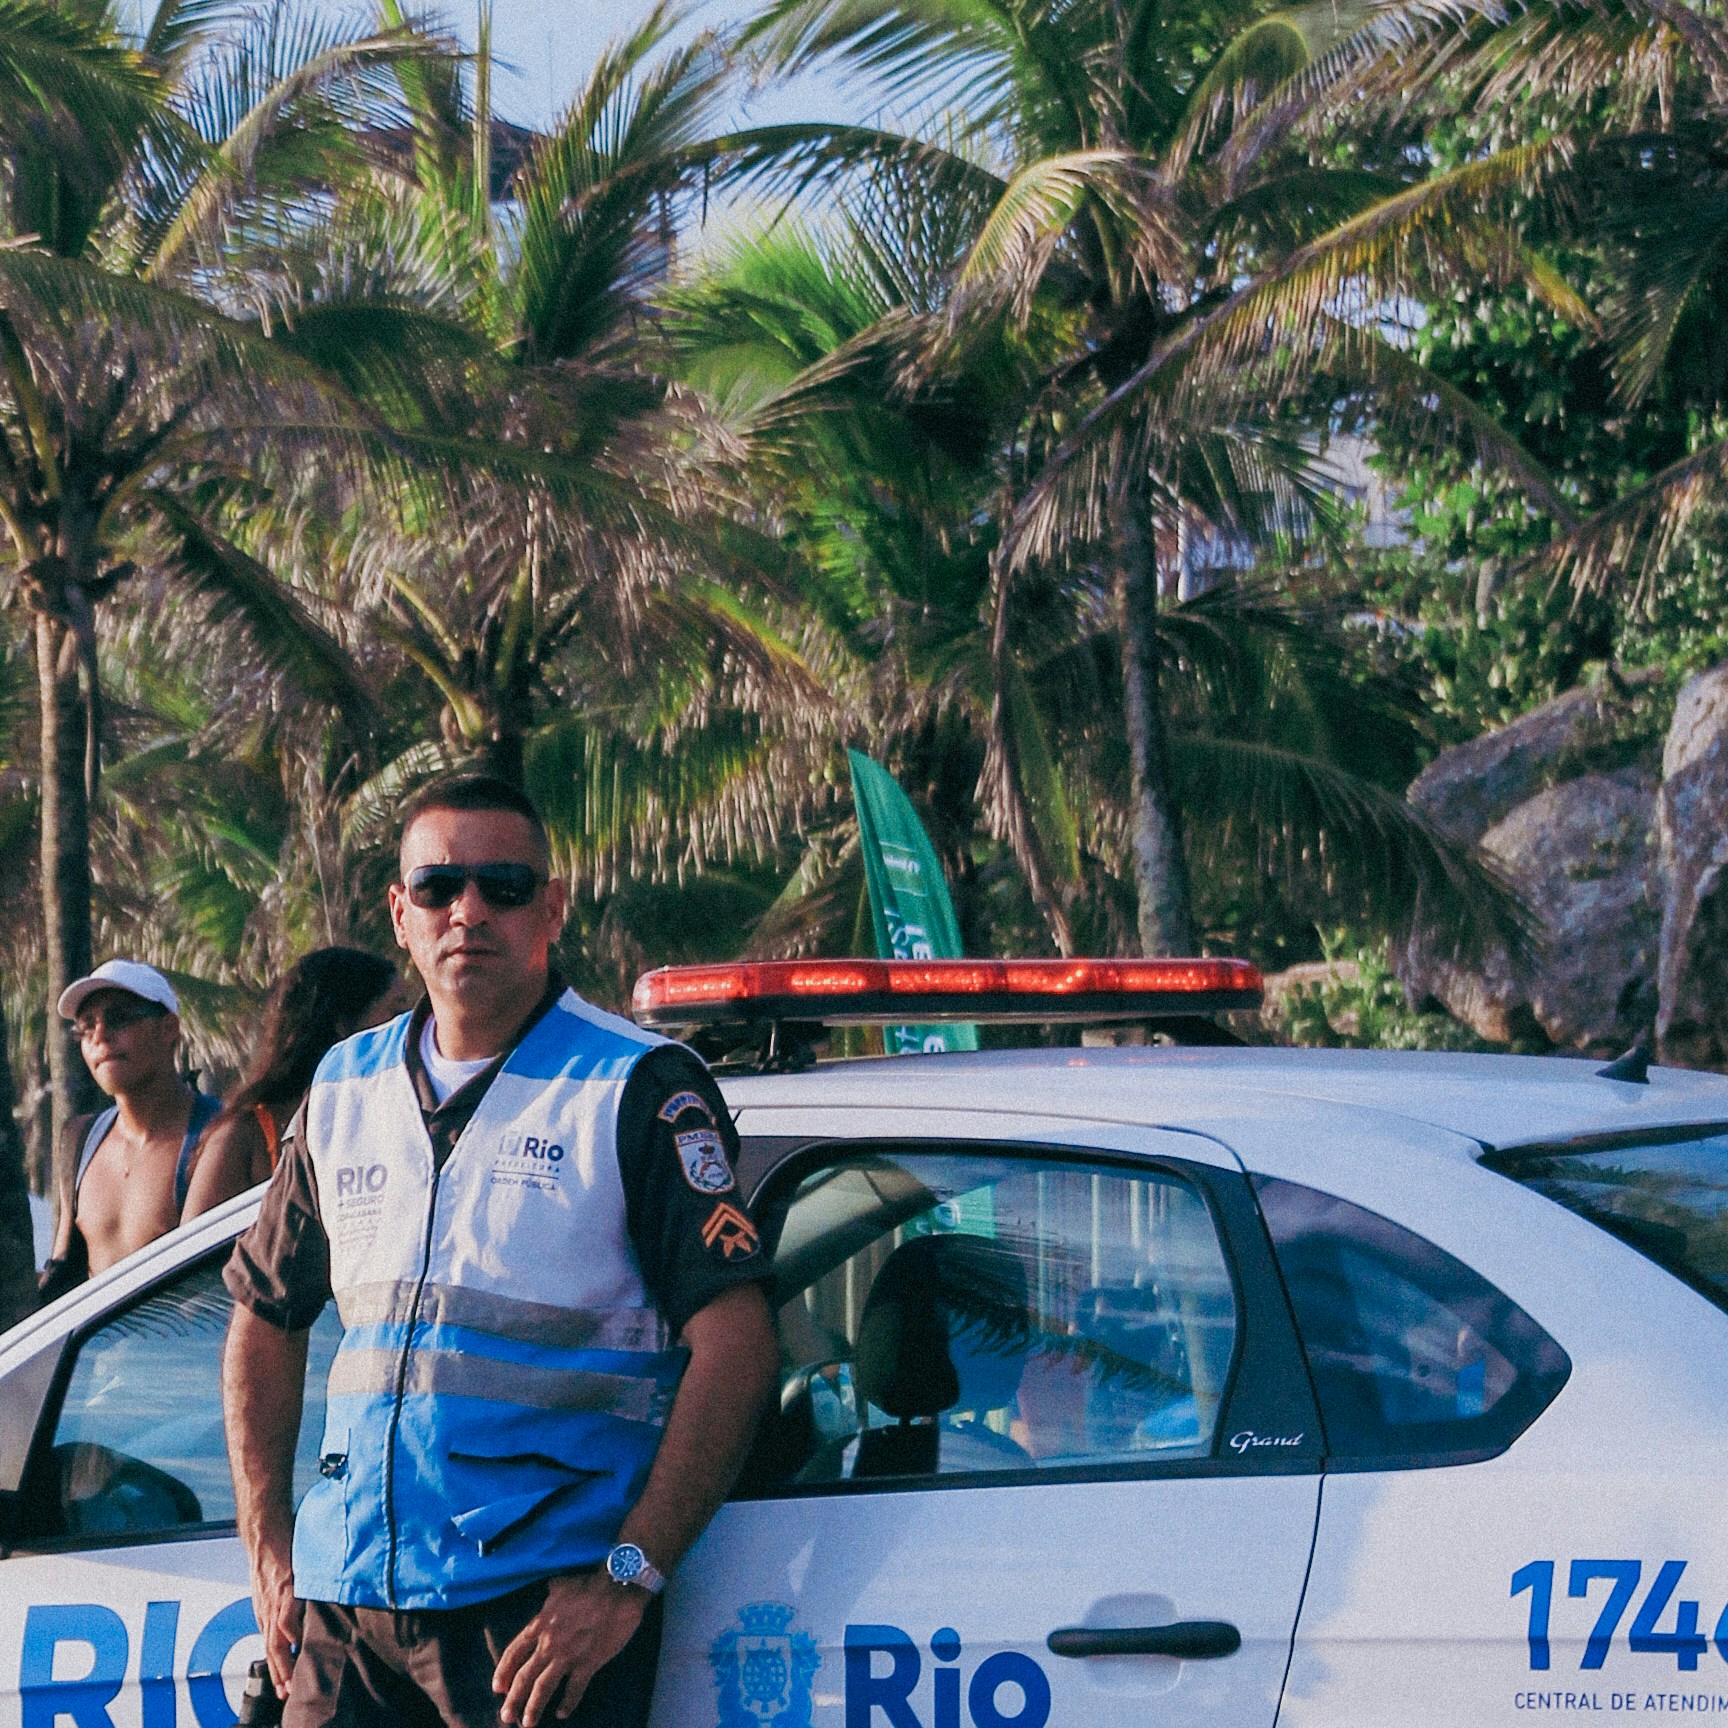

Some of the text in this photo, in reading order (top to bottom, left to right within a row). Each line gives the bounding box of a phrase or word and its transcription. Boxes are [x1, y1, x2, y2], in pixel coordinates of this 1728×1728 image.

[523, 1137, 564, 1162] Rio
[336, 1164, 388, 1198] RIO
[1229, 1430, 1304, 1455] Grand
[1514, 1692, 1603, 1710] CENTRAL
[1611, 1693, 1637, 1711] DE
